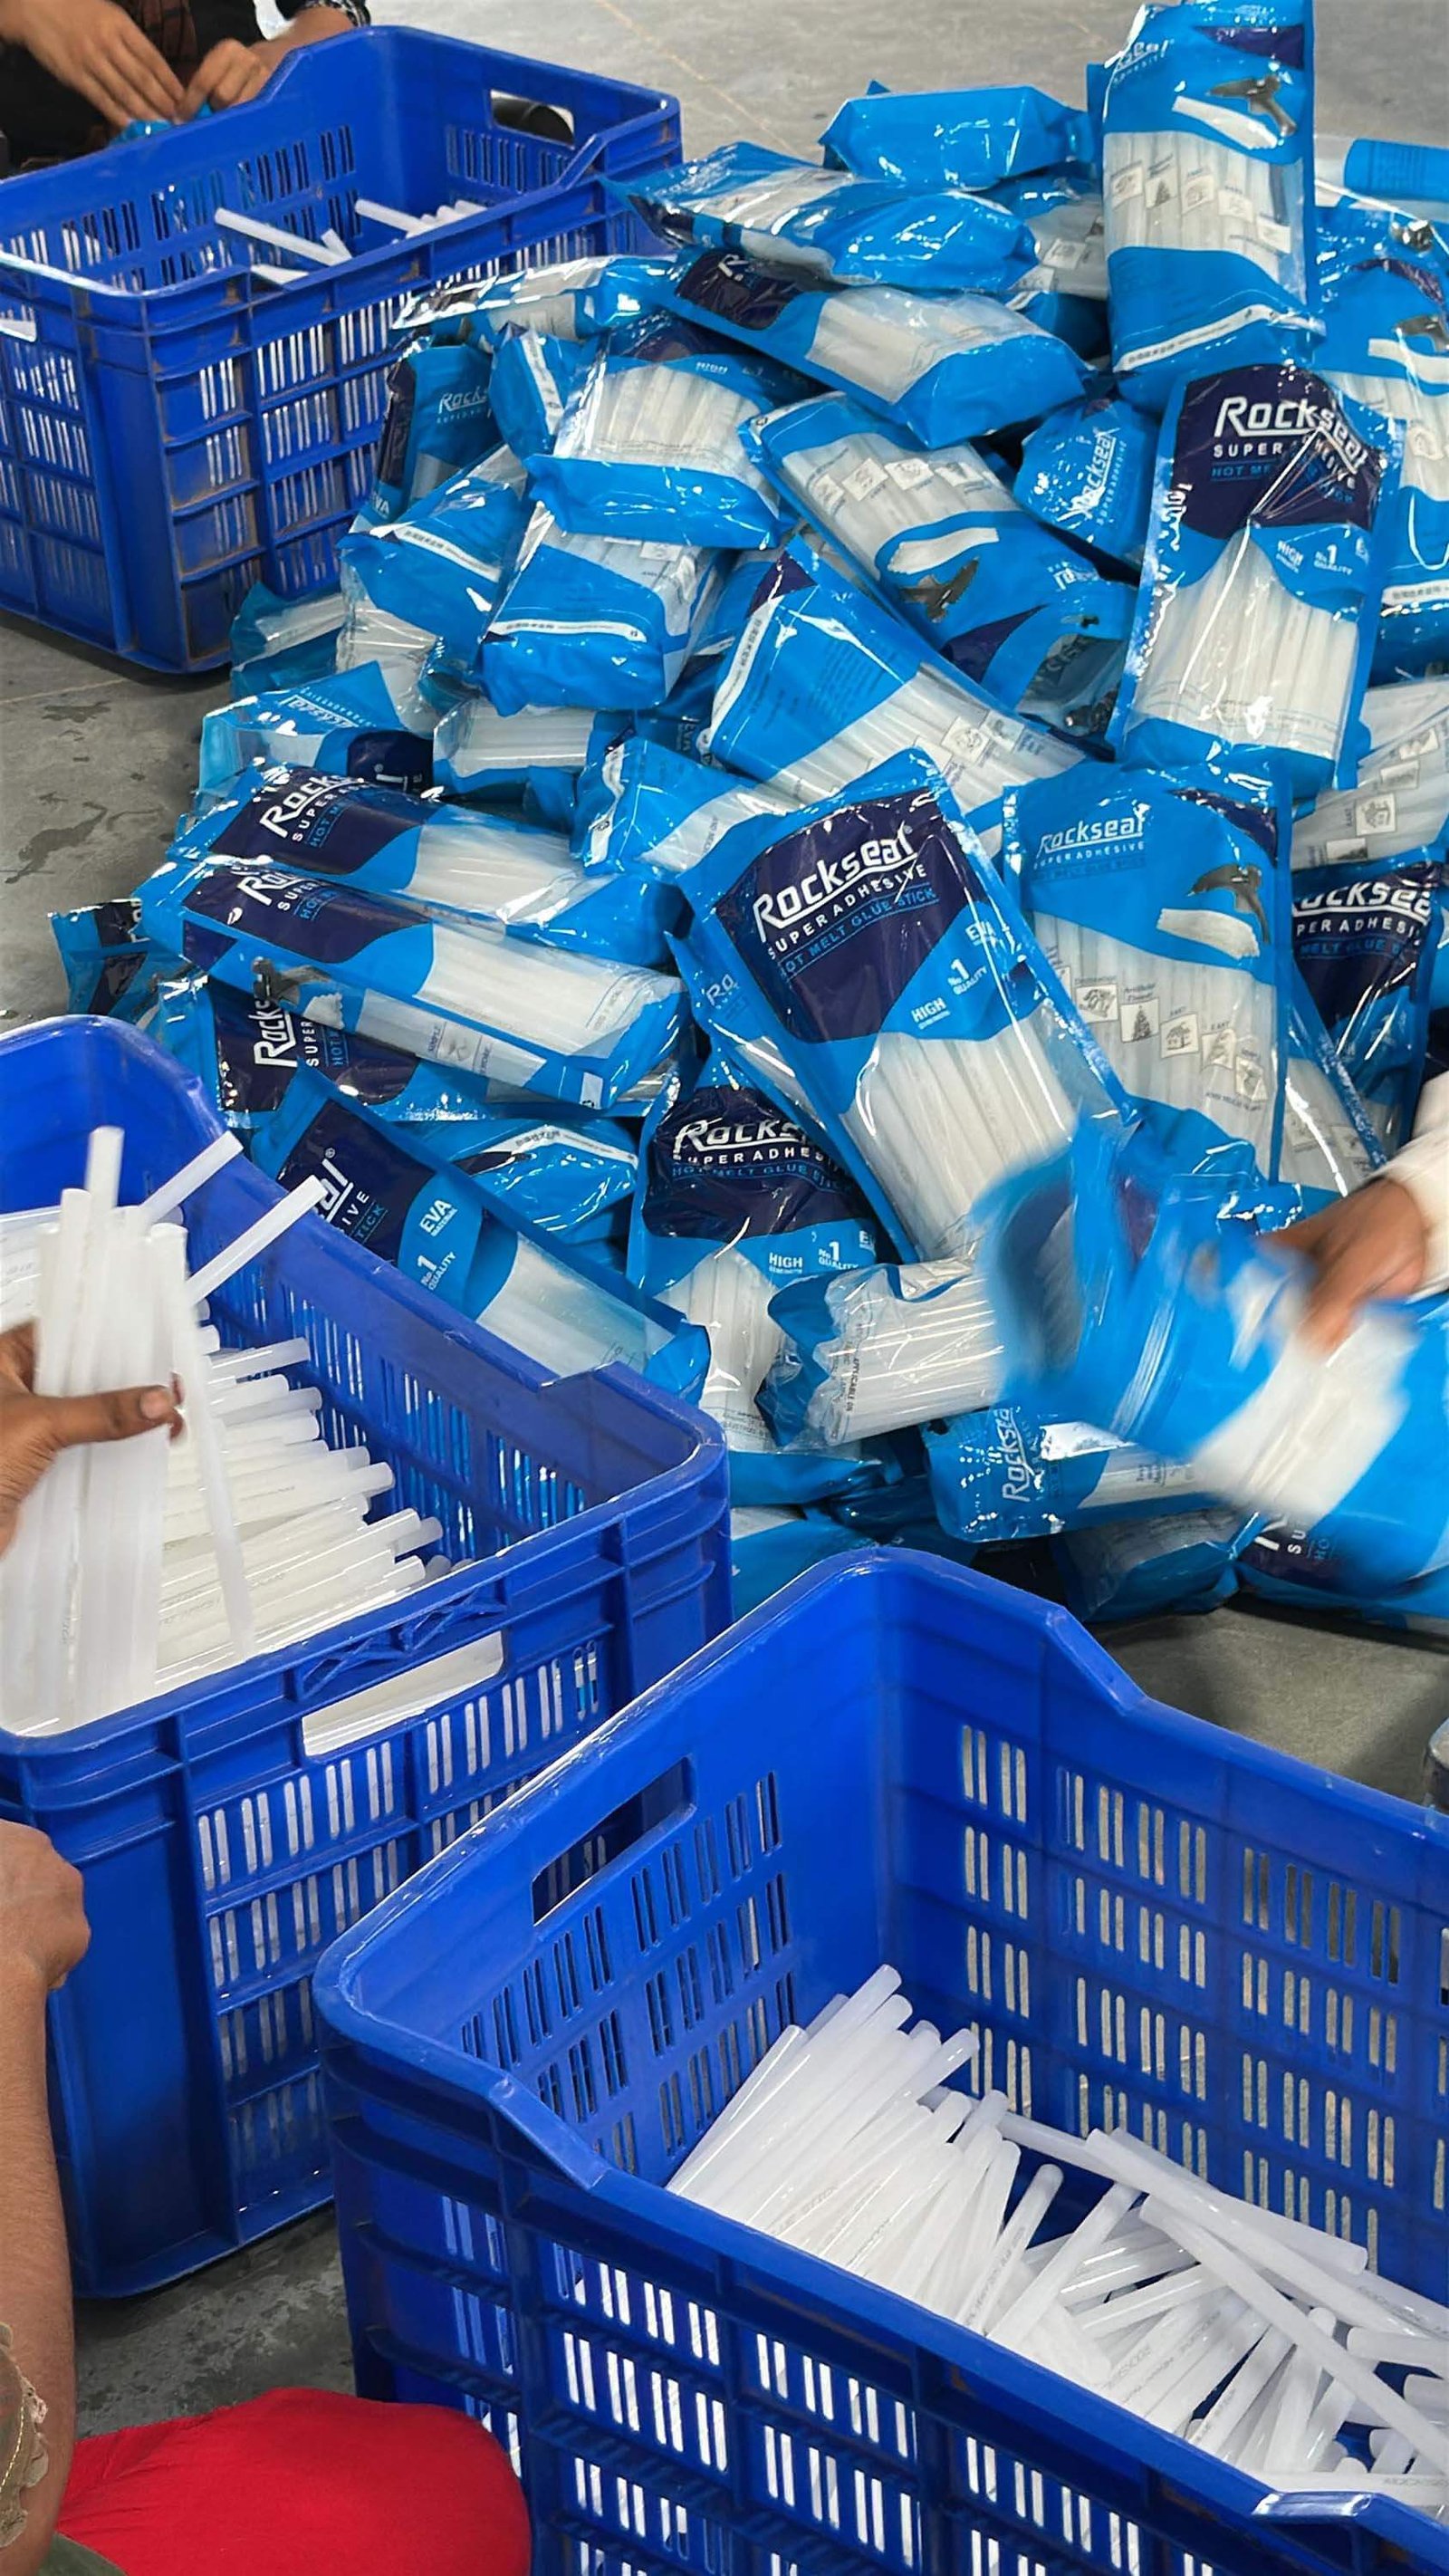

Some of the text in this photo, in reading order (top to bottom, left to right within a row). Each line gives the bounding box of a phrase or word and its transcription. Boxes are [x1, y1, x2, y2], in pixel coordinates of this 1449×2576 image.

[1214, 442, 1283, 459] SUPER
[1035, 808, 1145, 860] Rockseal
[753, 820, 918, 944] Rockseal
[767, 863, 928, 961] SUPER ADHESIVE
[809, 927, 847, 954] MELT
[849, 899, 893, 928] GLUE
[897, 886, 938, 907] STICK
[911, 997, 947, 1023] HIGH
[301, 1021, 321, 1067] SUPER
[419, 1199, 453, 1234] EVA
[427, 1251, 457, 1291] QUALITY
[769, 1251, 803, 1269] HIGH
